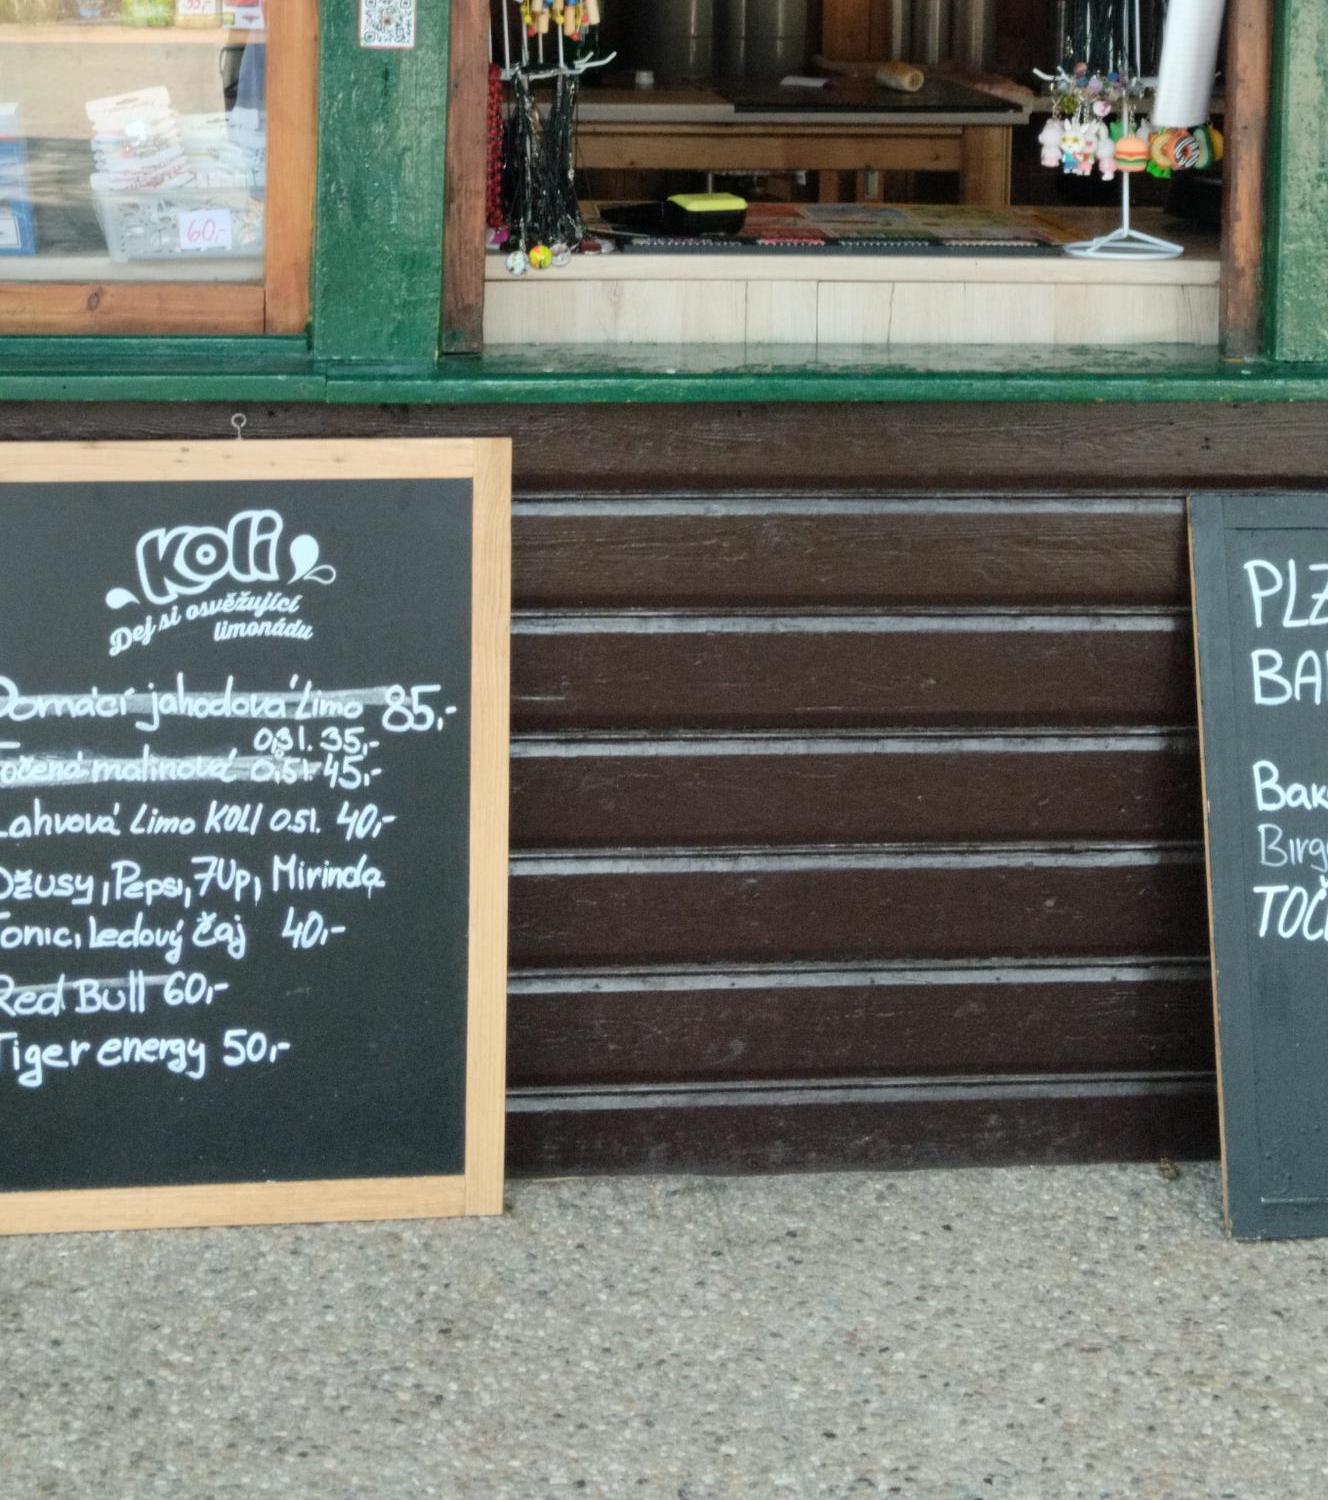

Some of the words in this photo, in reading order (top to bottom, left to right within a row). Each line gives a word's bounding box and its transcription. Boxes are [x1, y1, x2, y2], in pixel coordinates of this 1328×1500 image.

[109, 615, 156, 656] Dej
[158, 606, 182, 631] si
[186, 591, 303, 618] osvěžující
[213, 617, 314, 641] limonádu
[272, 854, 386, 898] Mirinda
[96, 1034, 207, 1079] energy
